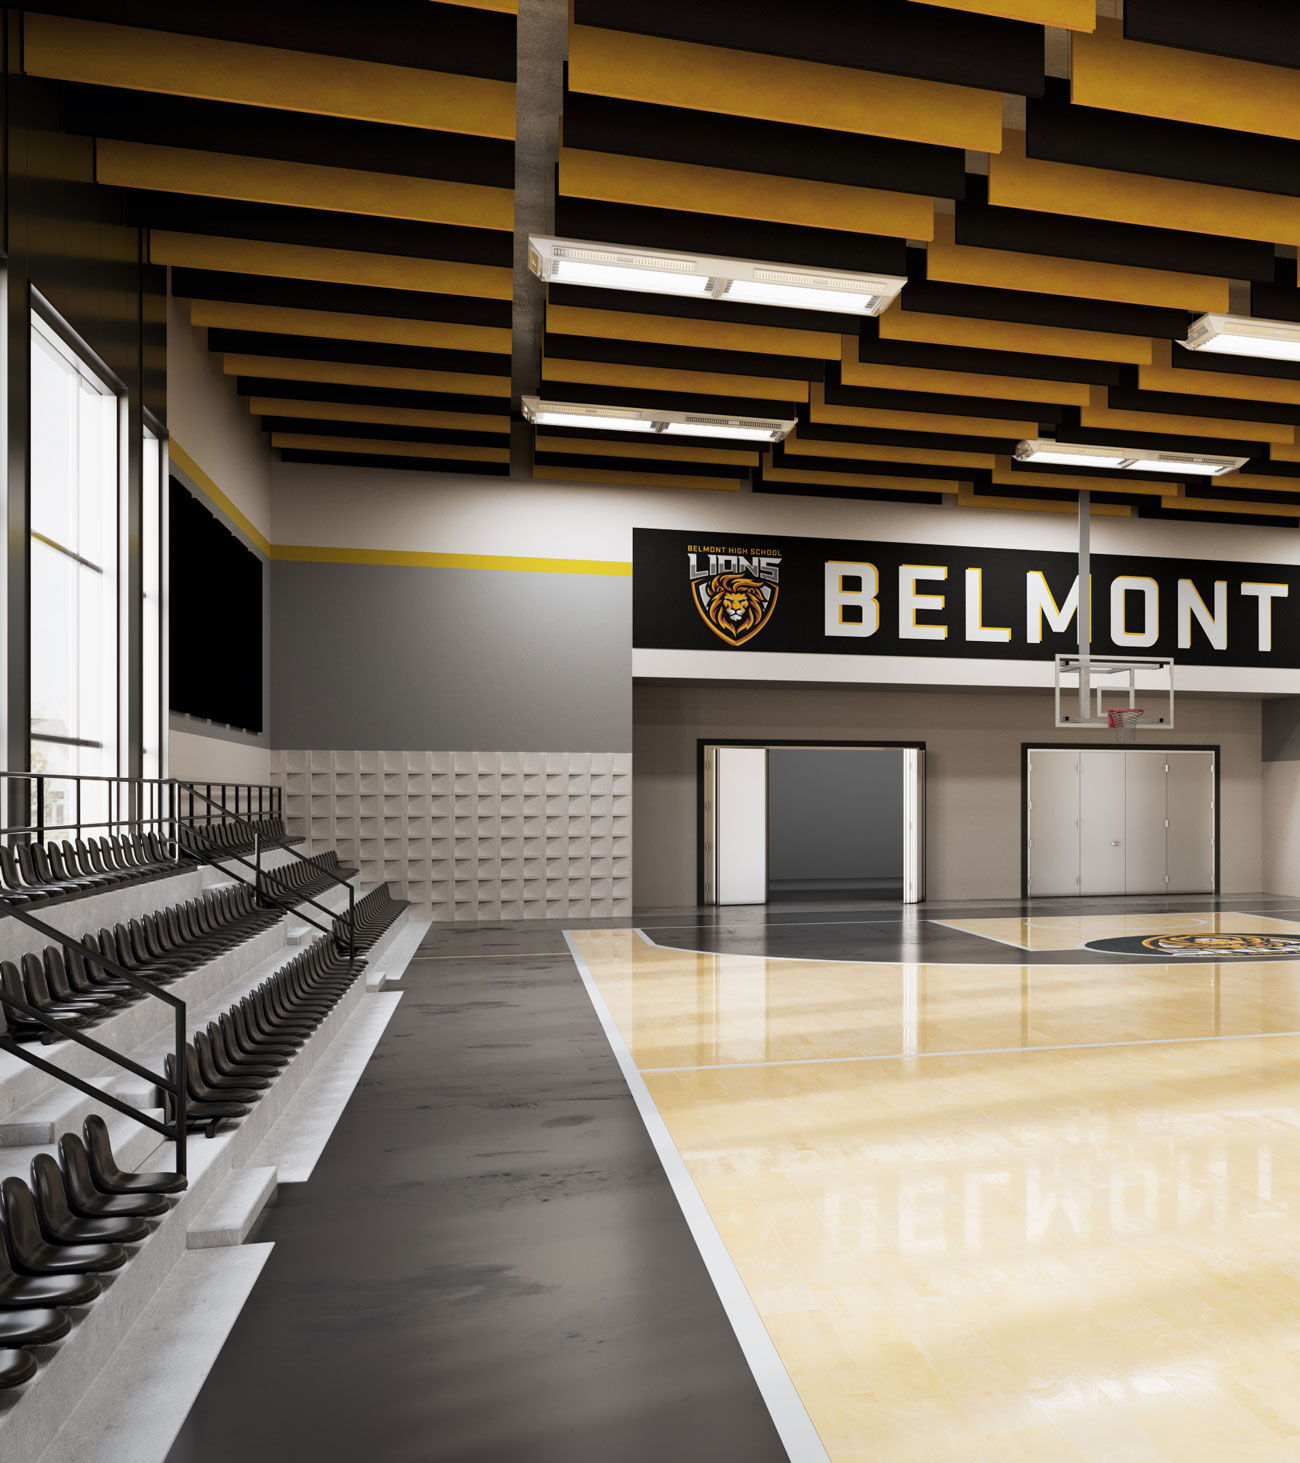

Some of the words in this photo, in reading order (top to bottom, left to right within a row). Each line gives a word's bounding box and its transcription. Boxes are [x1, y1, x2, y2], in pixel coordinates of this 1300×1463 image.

[687, 545, 727, 553] BELMONT
[728, 547, 748, 555] HIGH
[750, 548, 783, 557] SCHOOL
[687, 553, 783, 583] LIONS
[824, 560, 1289, 652] BELMONT
